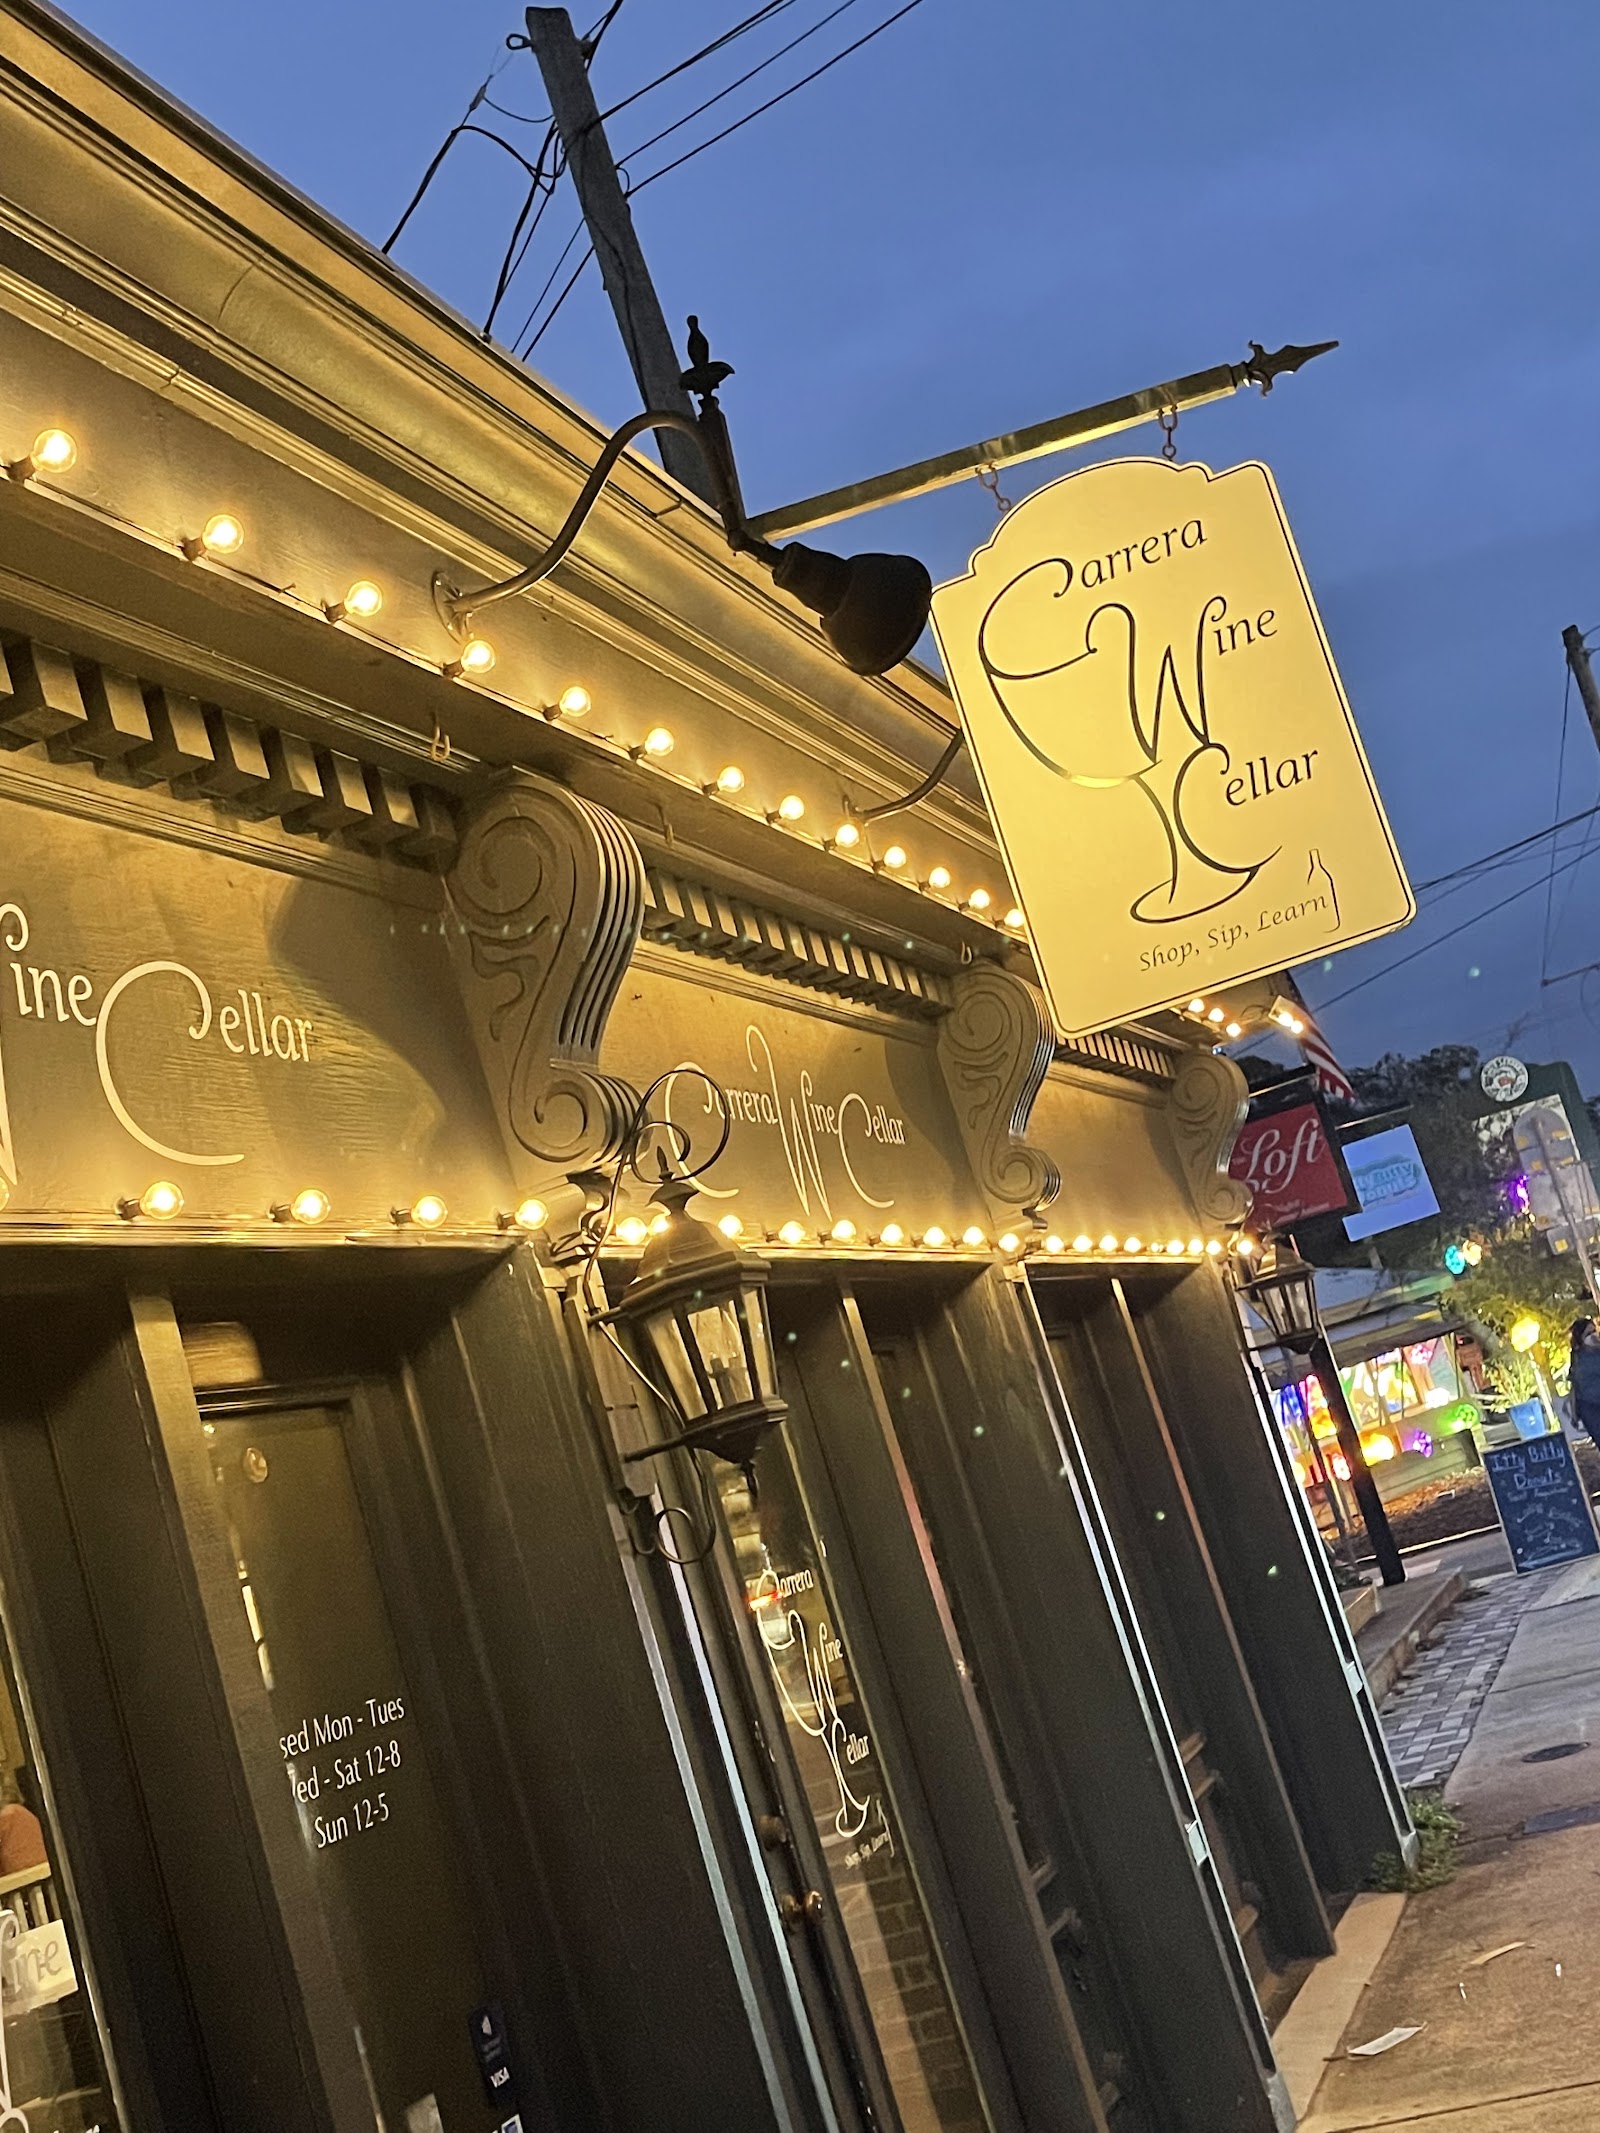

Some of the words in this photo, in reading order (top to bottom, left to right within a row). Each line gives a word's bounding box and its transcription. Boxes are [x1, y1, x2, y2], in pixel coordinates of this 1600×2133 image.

[978, 518, 1208, 680] Carrera
[1086, 595, 1279, 763] Wine
[1173, 741, 1319, 874] Cellar
[1139, 941, 1200, 972] Shop,
[1207, 923, 1249, 950] Sip,
[1256, 895, 1328, 932] Learn
[96, 960, 313, 1166] Cellar
[746, 1024, 839, 1221] Wine
[838, 1093, 905, 1208] Cellar
[1240, 1118, 1326, 1194] Loft
[1528, 1441, 1566, 1468] Bitty
[313, 1714, 353, 1747] Mon
[365, 1697, 405, 1727] Tues
[334, 1757, 363, 1790] Sat
[365, 1739, 401, 1777] 12-8
[314, 1816, 349, 1849] Sun
[353, 1792, 389, 1832] 12-5
